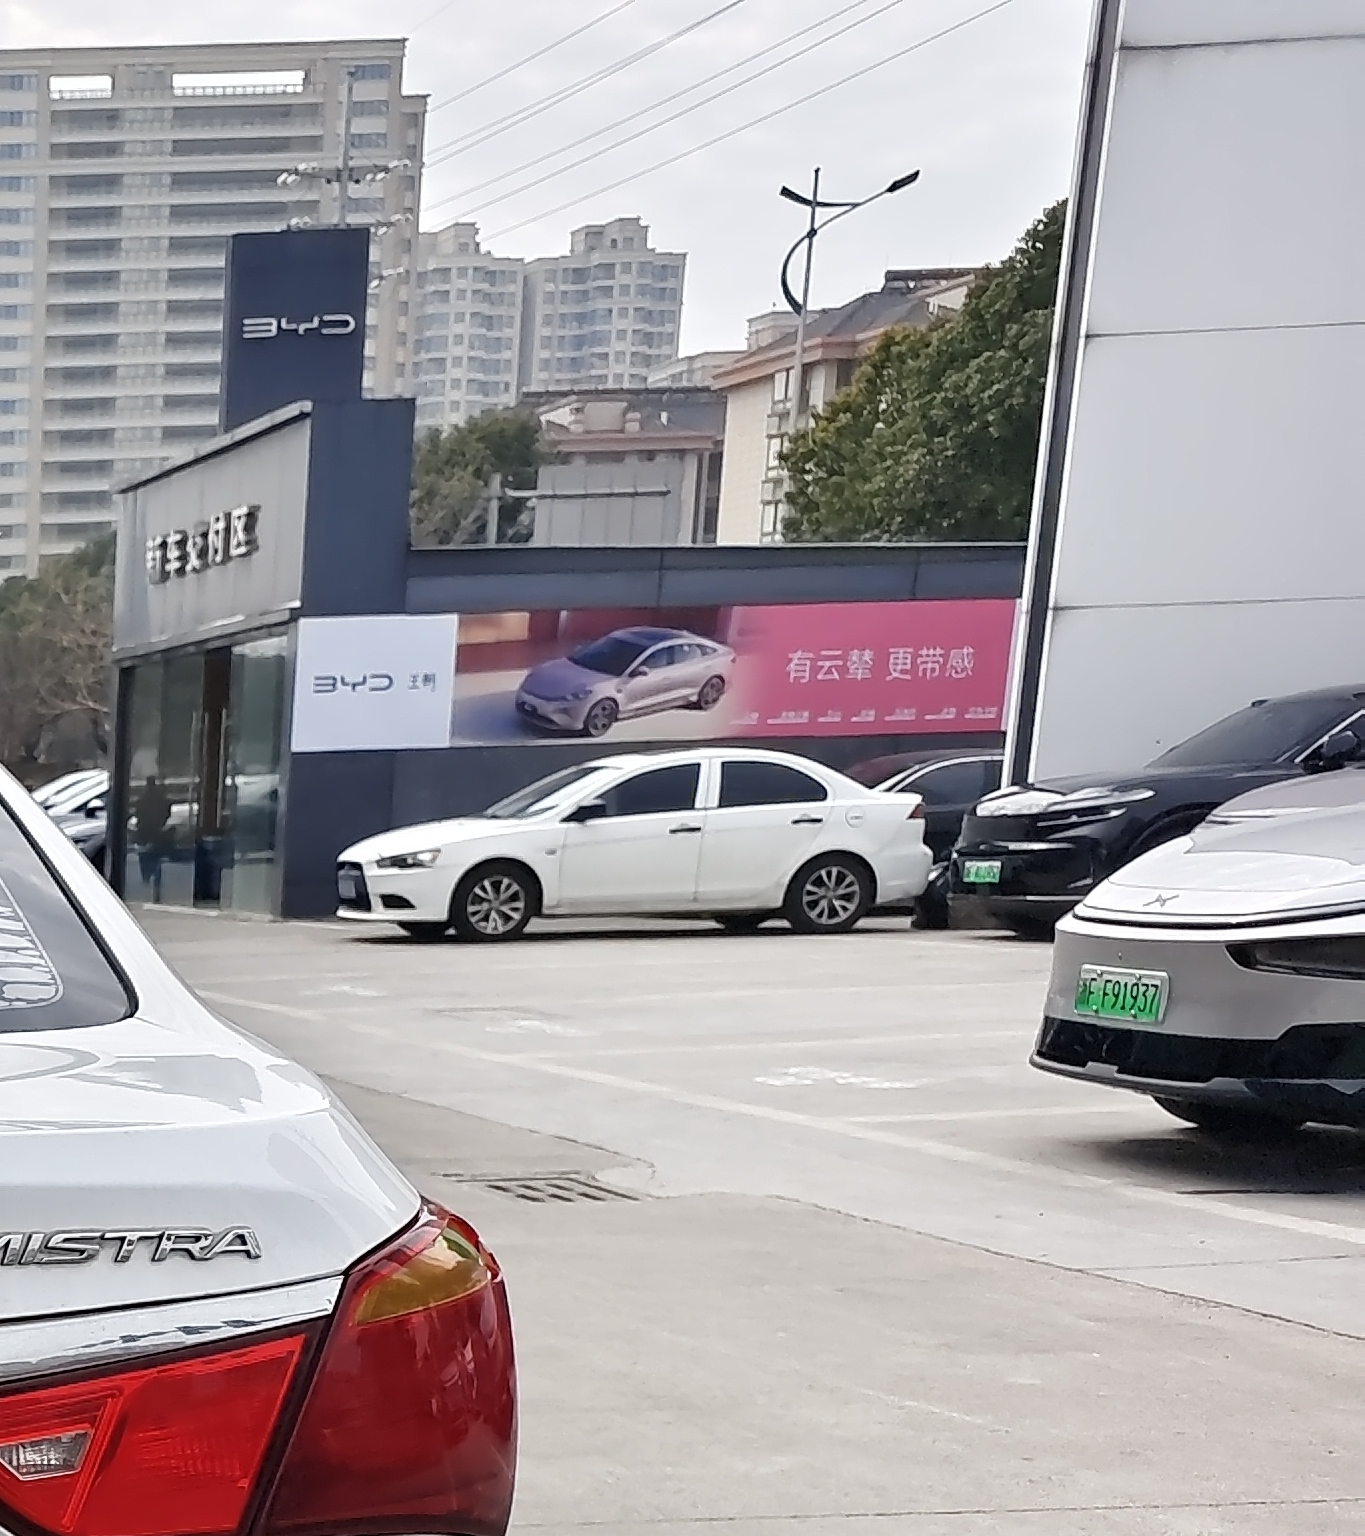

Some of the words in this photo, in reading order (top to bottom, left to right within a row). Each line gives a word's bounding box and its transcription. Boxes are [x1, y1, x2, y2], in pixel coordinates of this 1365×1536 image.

[242, 313, 356, 339] BYD
[885, 645, 974, 681] 更带感
[313, 673, 394, 693] BYD
